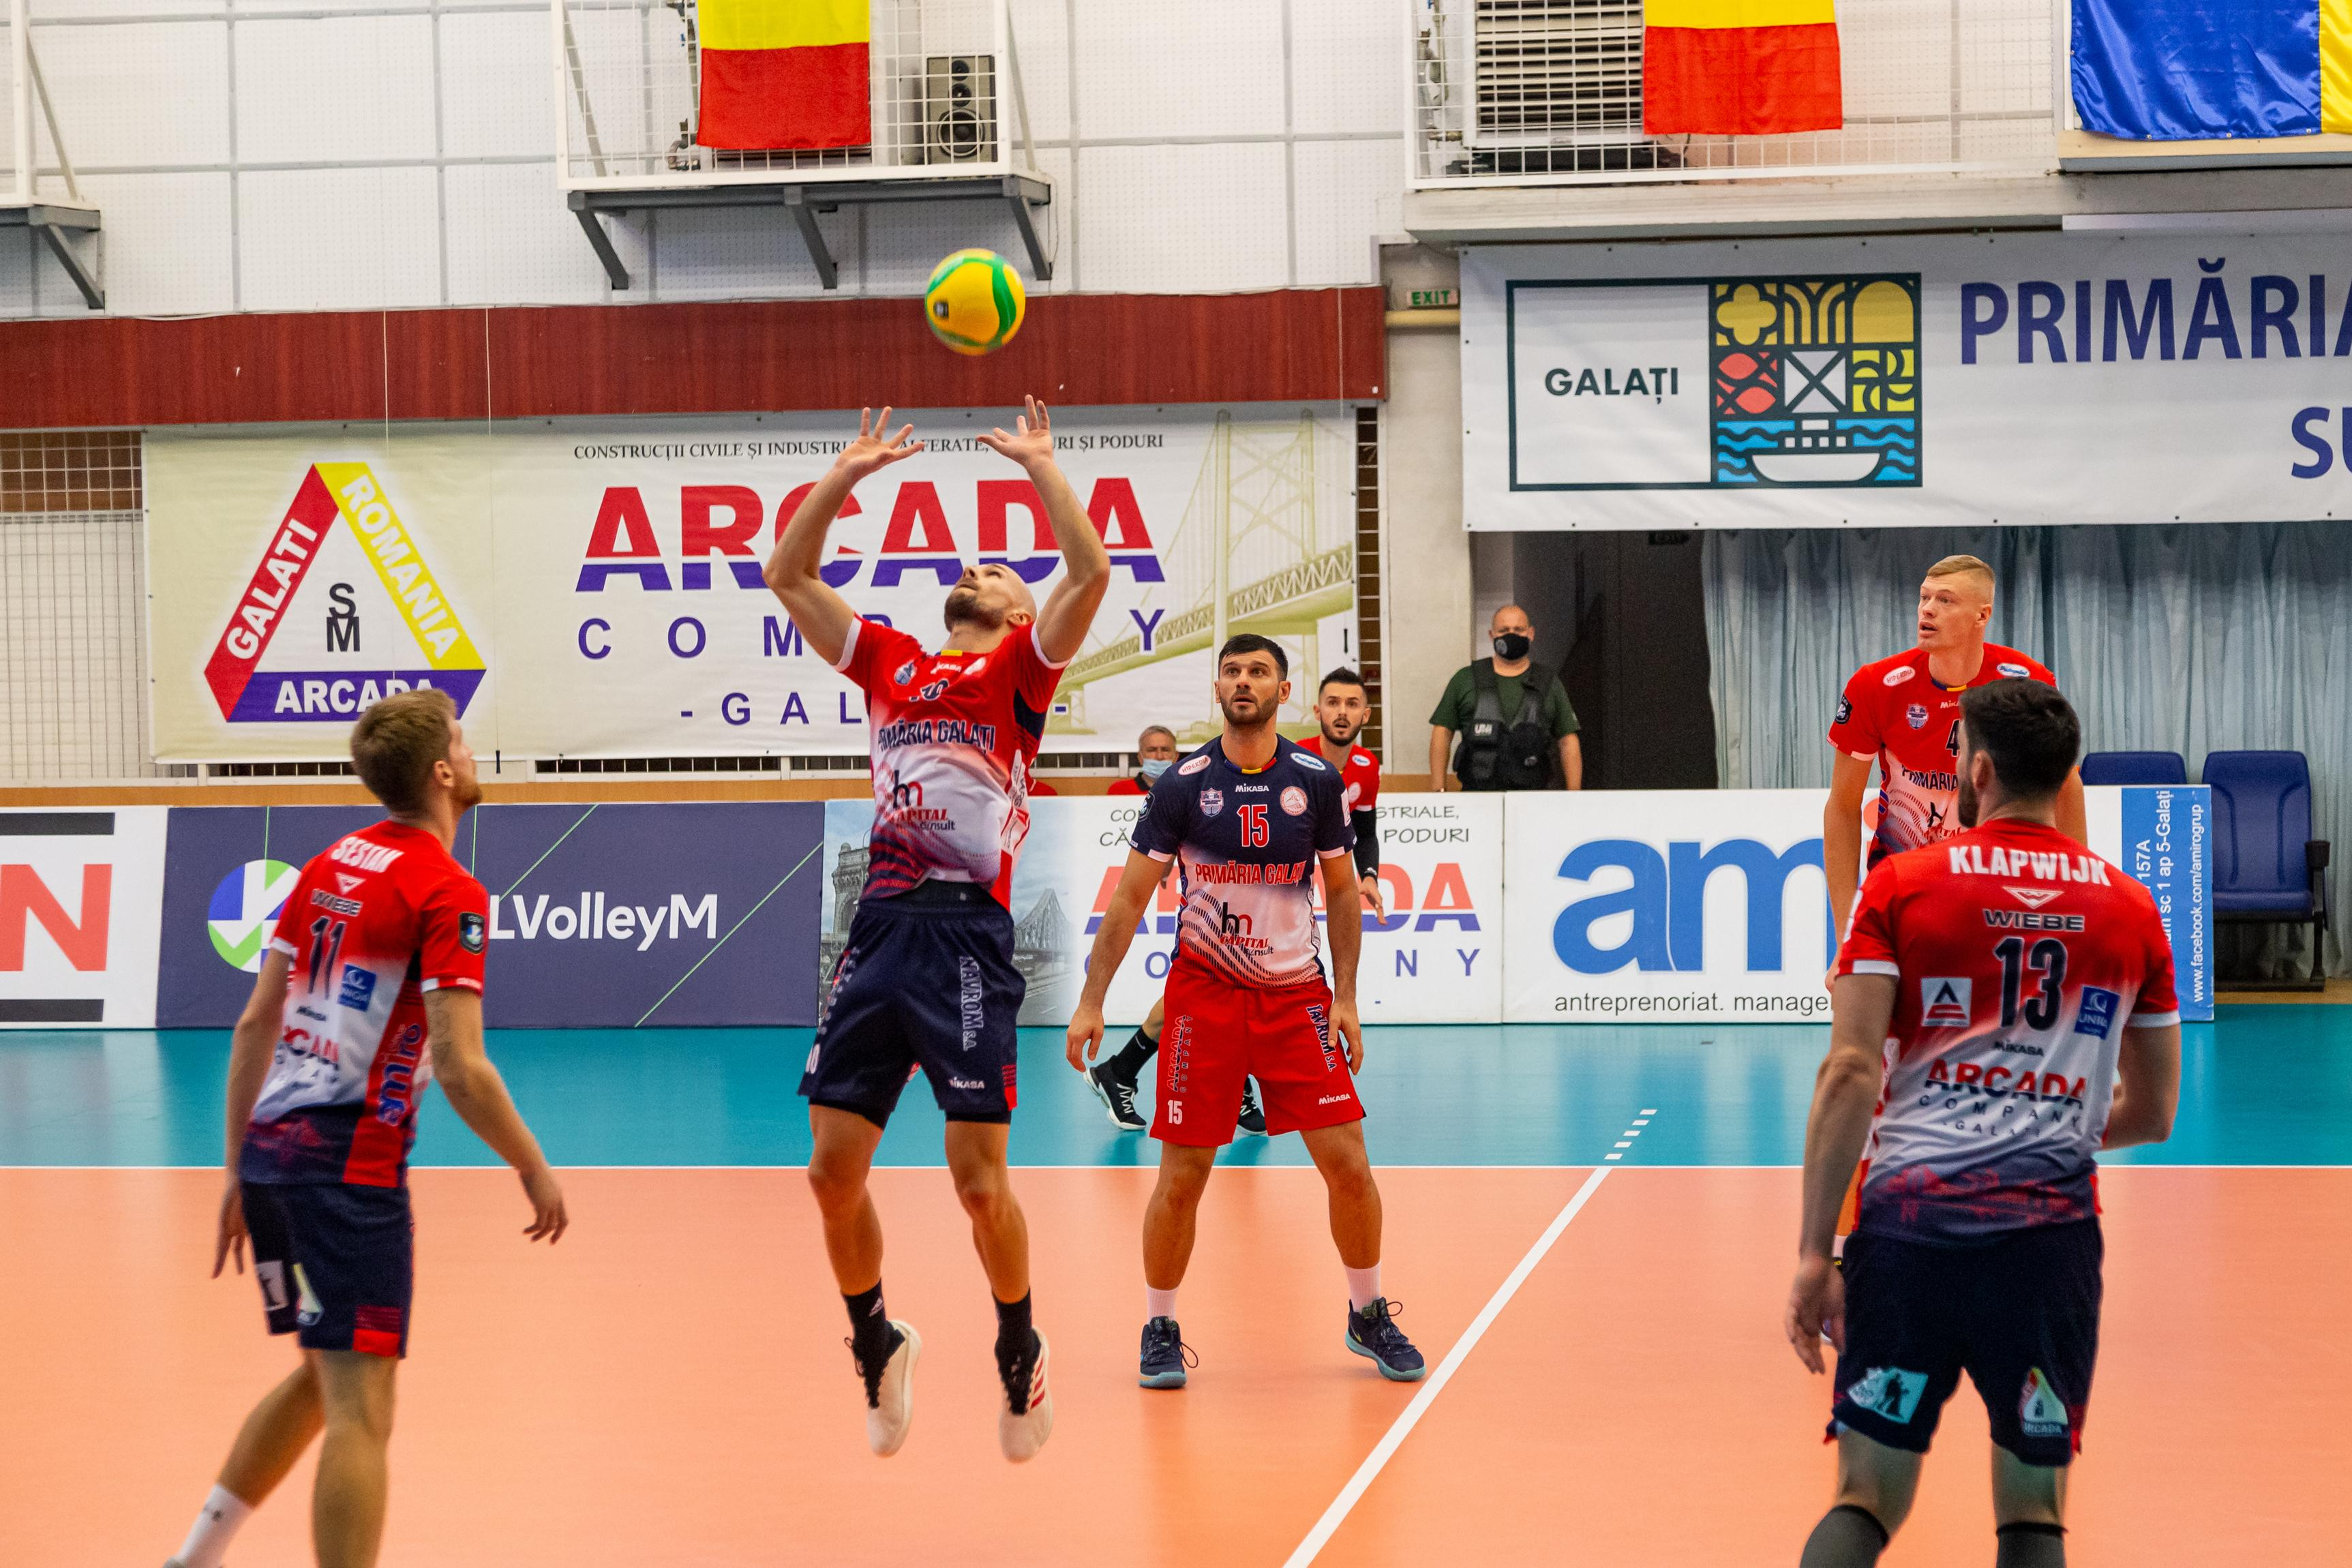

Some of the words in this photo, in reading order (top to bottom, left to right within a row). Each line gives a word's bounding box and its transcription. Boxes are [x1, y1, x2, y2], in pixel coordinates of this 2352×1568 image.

[1411, 290, 1451, 305] EXIT
[1545, 367, 1678, 404] GALAȚI
[575, 444, 684, 462] CONSTRUCȚII
[690, 442, 743, 457] CIVILE
[747, 442, 762, 460] ȘI
[768, 440, 854, 456] INDUSTRI
[1079, 435, 1094, 453] ȘI
[1100, 434, 1163, 449] PODURI
[341, 474, 461, 659] ROMANIA
[226, 518, 318, 660] GALATI
[1945, 718, 1961, 757] 4
[1237, 804, 1269, 848] 15
[1376, 805, 1460, 820] STRIALE,
[1384, 828, 1469, 843] PODURI
[1948, 845, 2111, 887] KLAPWIJK
[2136, 839, 2151, 879] 157A
[2159, 856, 2175, 877] ap
[489, 890, 719, 952] LVolleyM
[1982, 908, 2085, 933] WIEBE
[307, 916, 348, 1000] 11
[1994, 936, 2068, 1031] 13
[1554, 991, 1725, 1016] antreprenoriat.
[1734, 995, 1834, 1016] manage
[1166, 1014, 1187, 1093] ARCADA
[1925, 1058, 2087, 1111] ARCADA
[1167, 1099, 1183, 1125] 15
